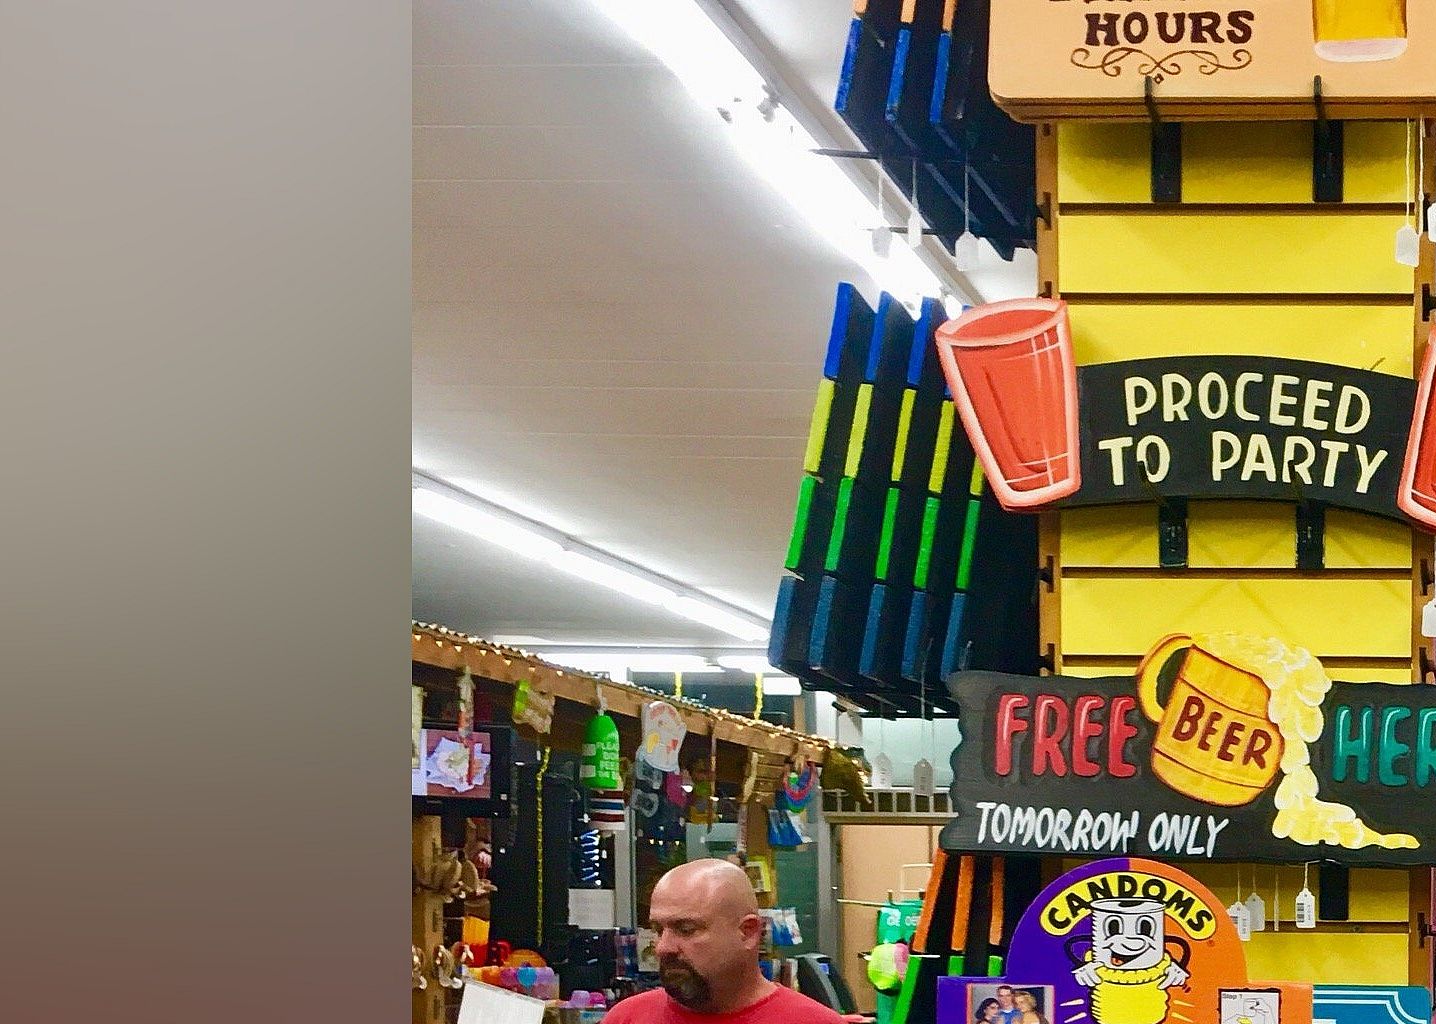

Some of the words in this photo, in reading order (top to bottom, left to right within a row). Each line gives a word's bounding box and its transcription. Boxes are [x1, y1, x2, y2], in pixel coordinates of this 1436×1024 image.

[1084, 10, 1255, 46] HOURS
[1125, 371, 1371, 436] PROCEED
[1098, 436, 1171, 487] TO
[1211, 429, 1389, 496] PARTY
[994, 691, 1139, 780] FREE
[1171, 694, 1275, 772] BEER
[975, 801, 1140, 856] TOMORROW
[1148, 810, 1230, 858] ONLY
[1046, 874, 1215, 932] CANDOMS
